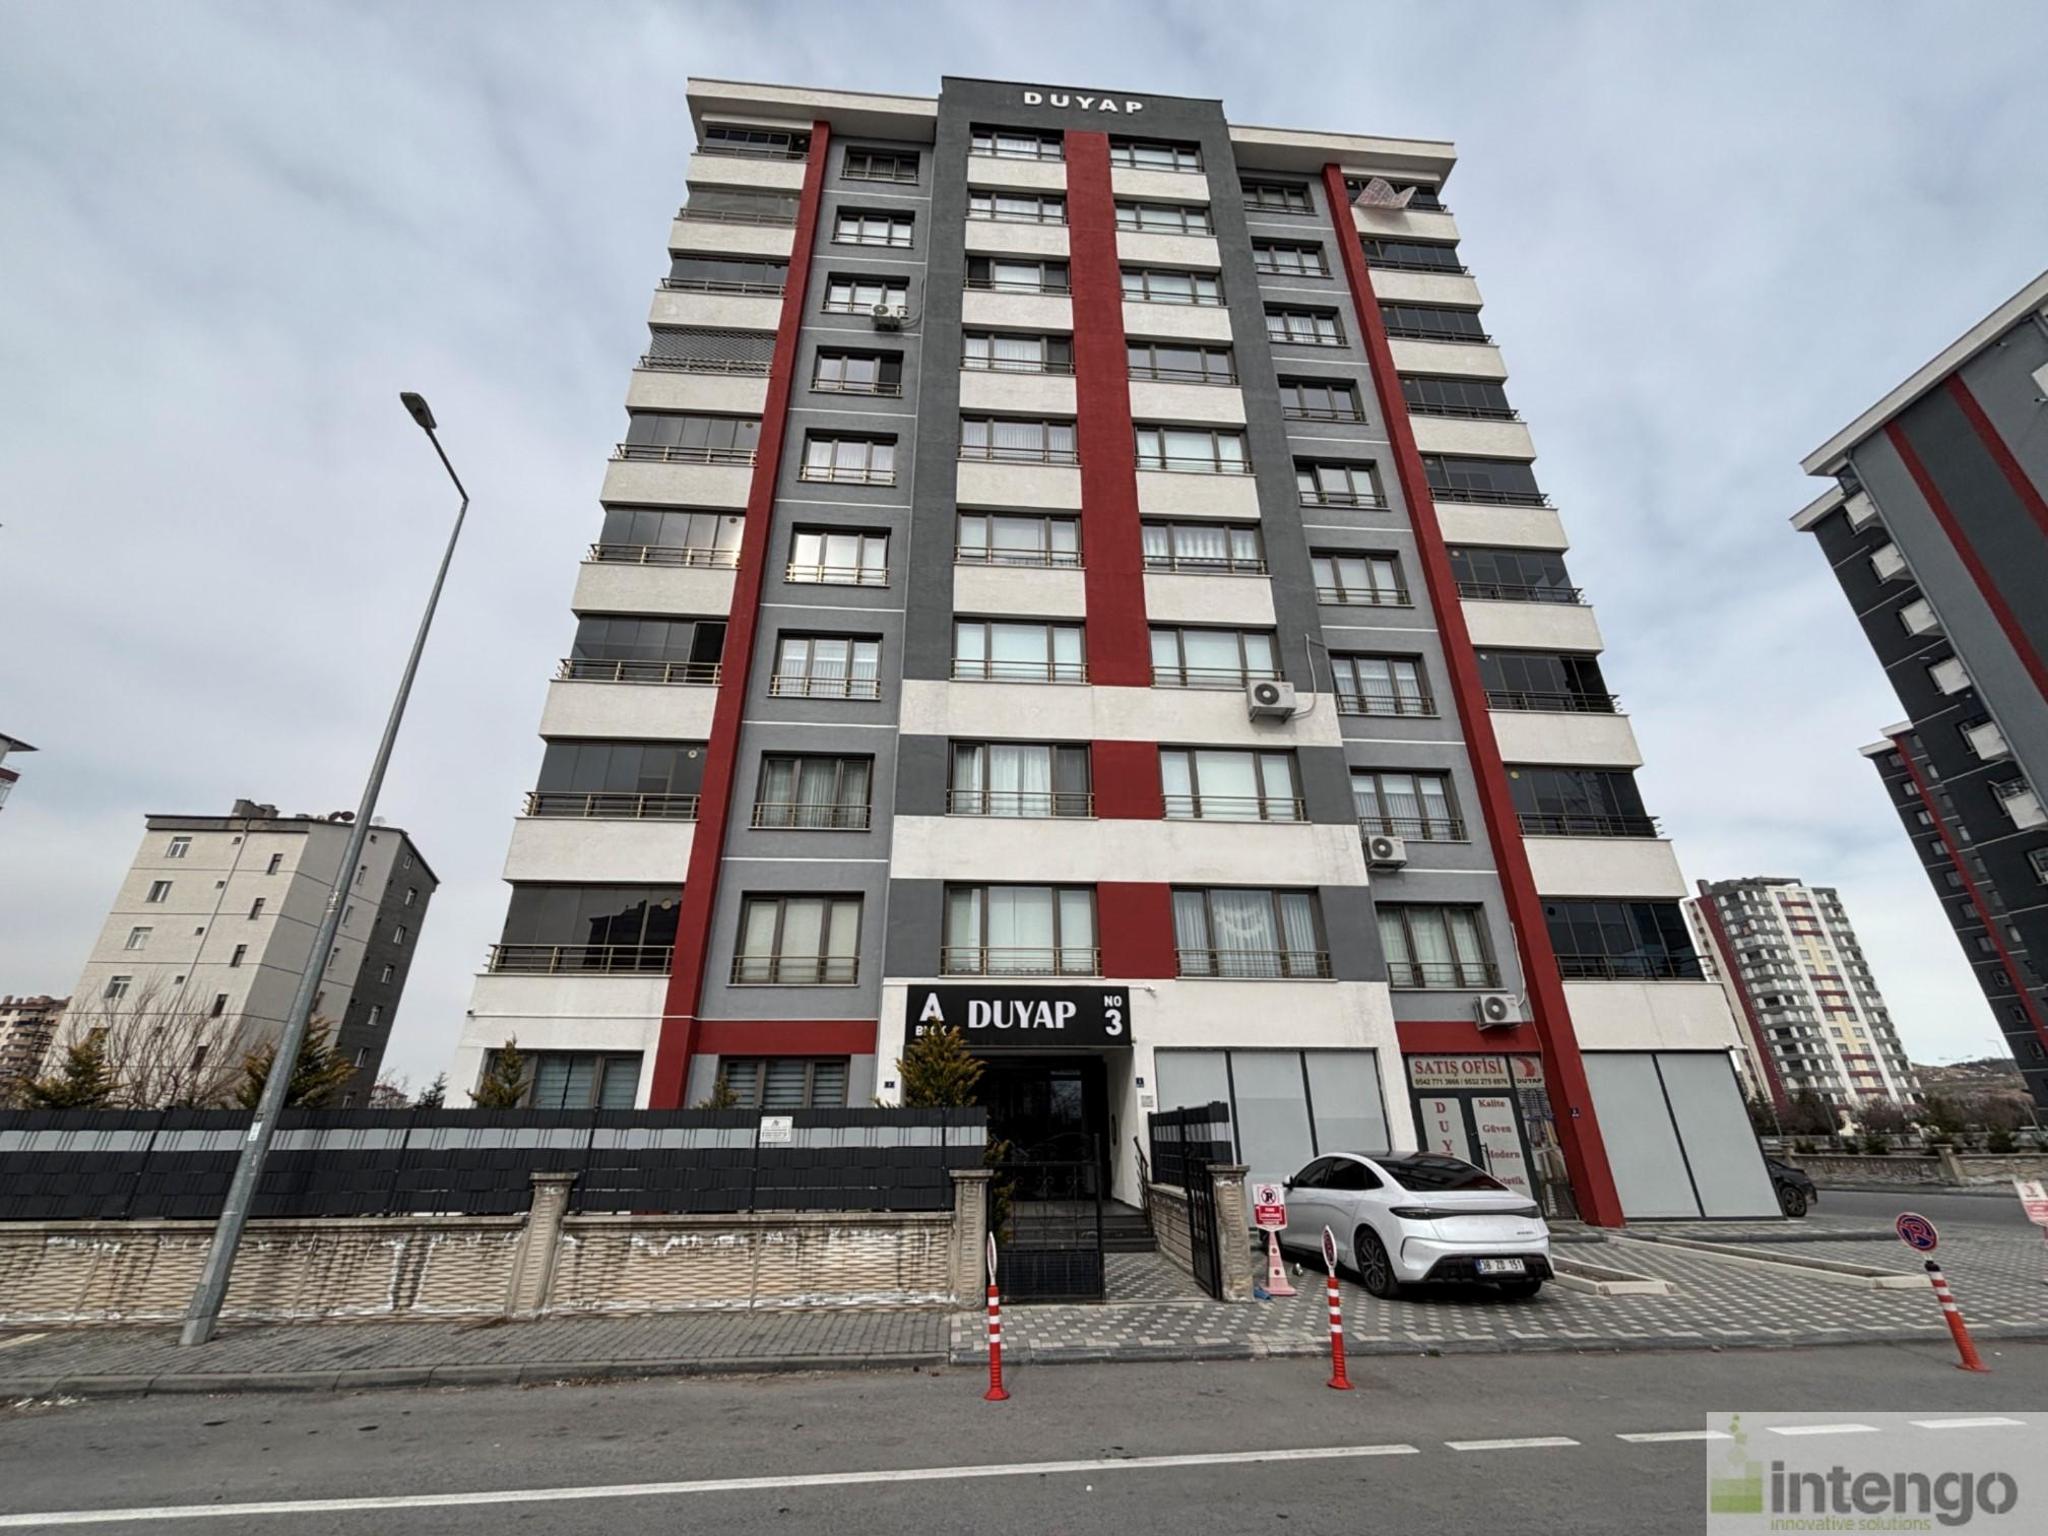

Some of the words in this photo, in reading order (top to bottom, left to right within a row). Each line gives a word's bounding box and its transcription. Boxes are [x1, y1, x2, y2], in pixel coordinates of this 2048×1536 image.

[1023, 91, 1144, 113] DUYAP
[919, 992, 945, 1021] A
[1104, 995, 1122, 1007] NO
[967, 1000, 1077, 1028] DUYAP
[1105, 1009, 1123, 1036] 3
[1414, 1060, 1458, 1076] SATIŞ
[1462, 1057, 1503, 1074] OFİSİ
[1478, 1099, 1505, 1108] Kalite
[1482, 1124, 1512, 1133] Güven
